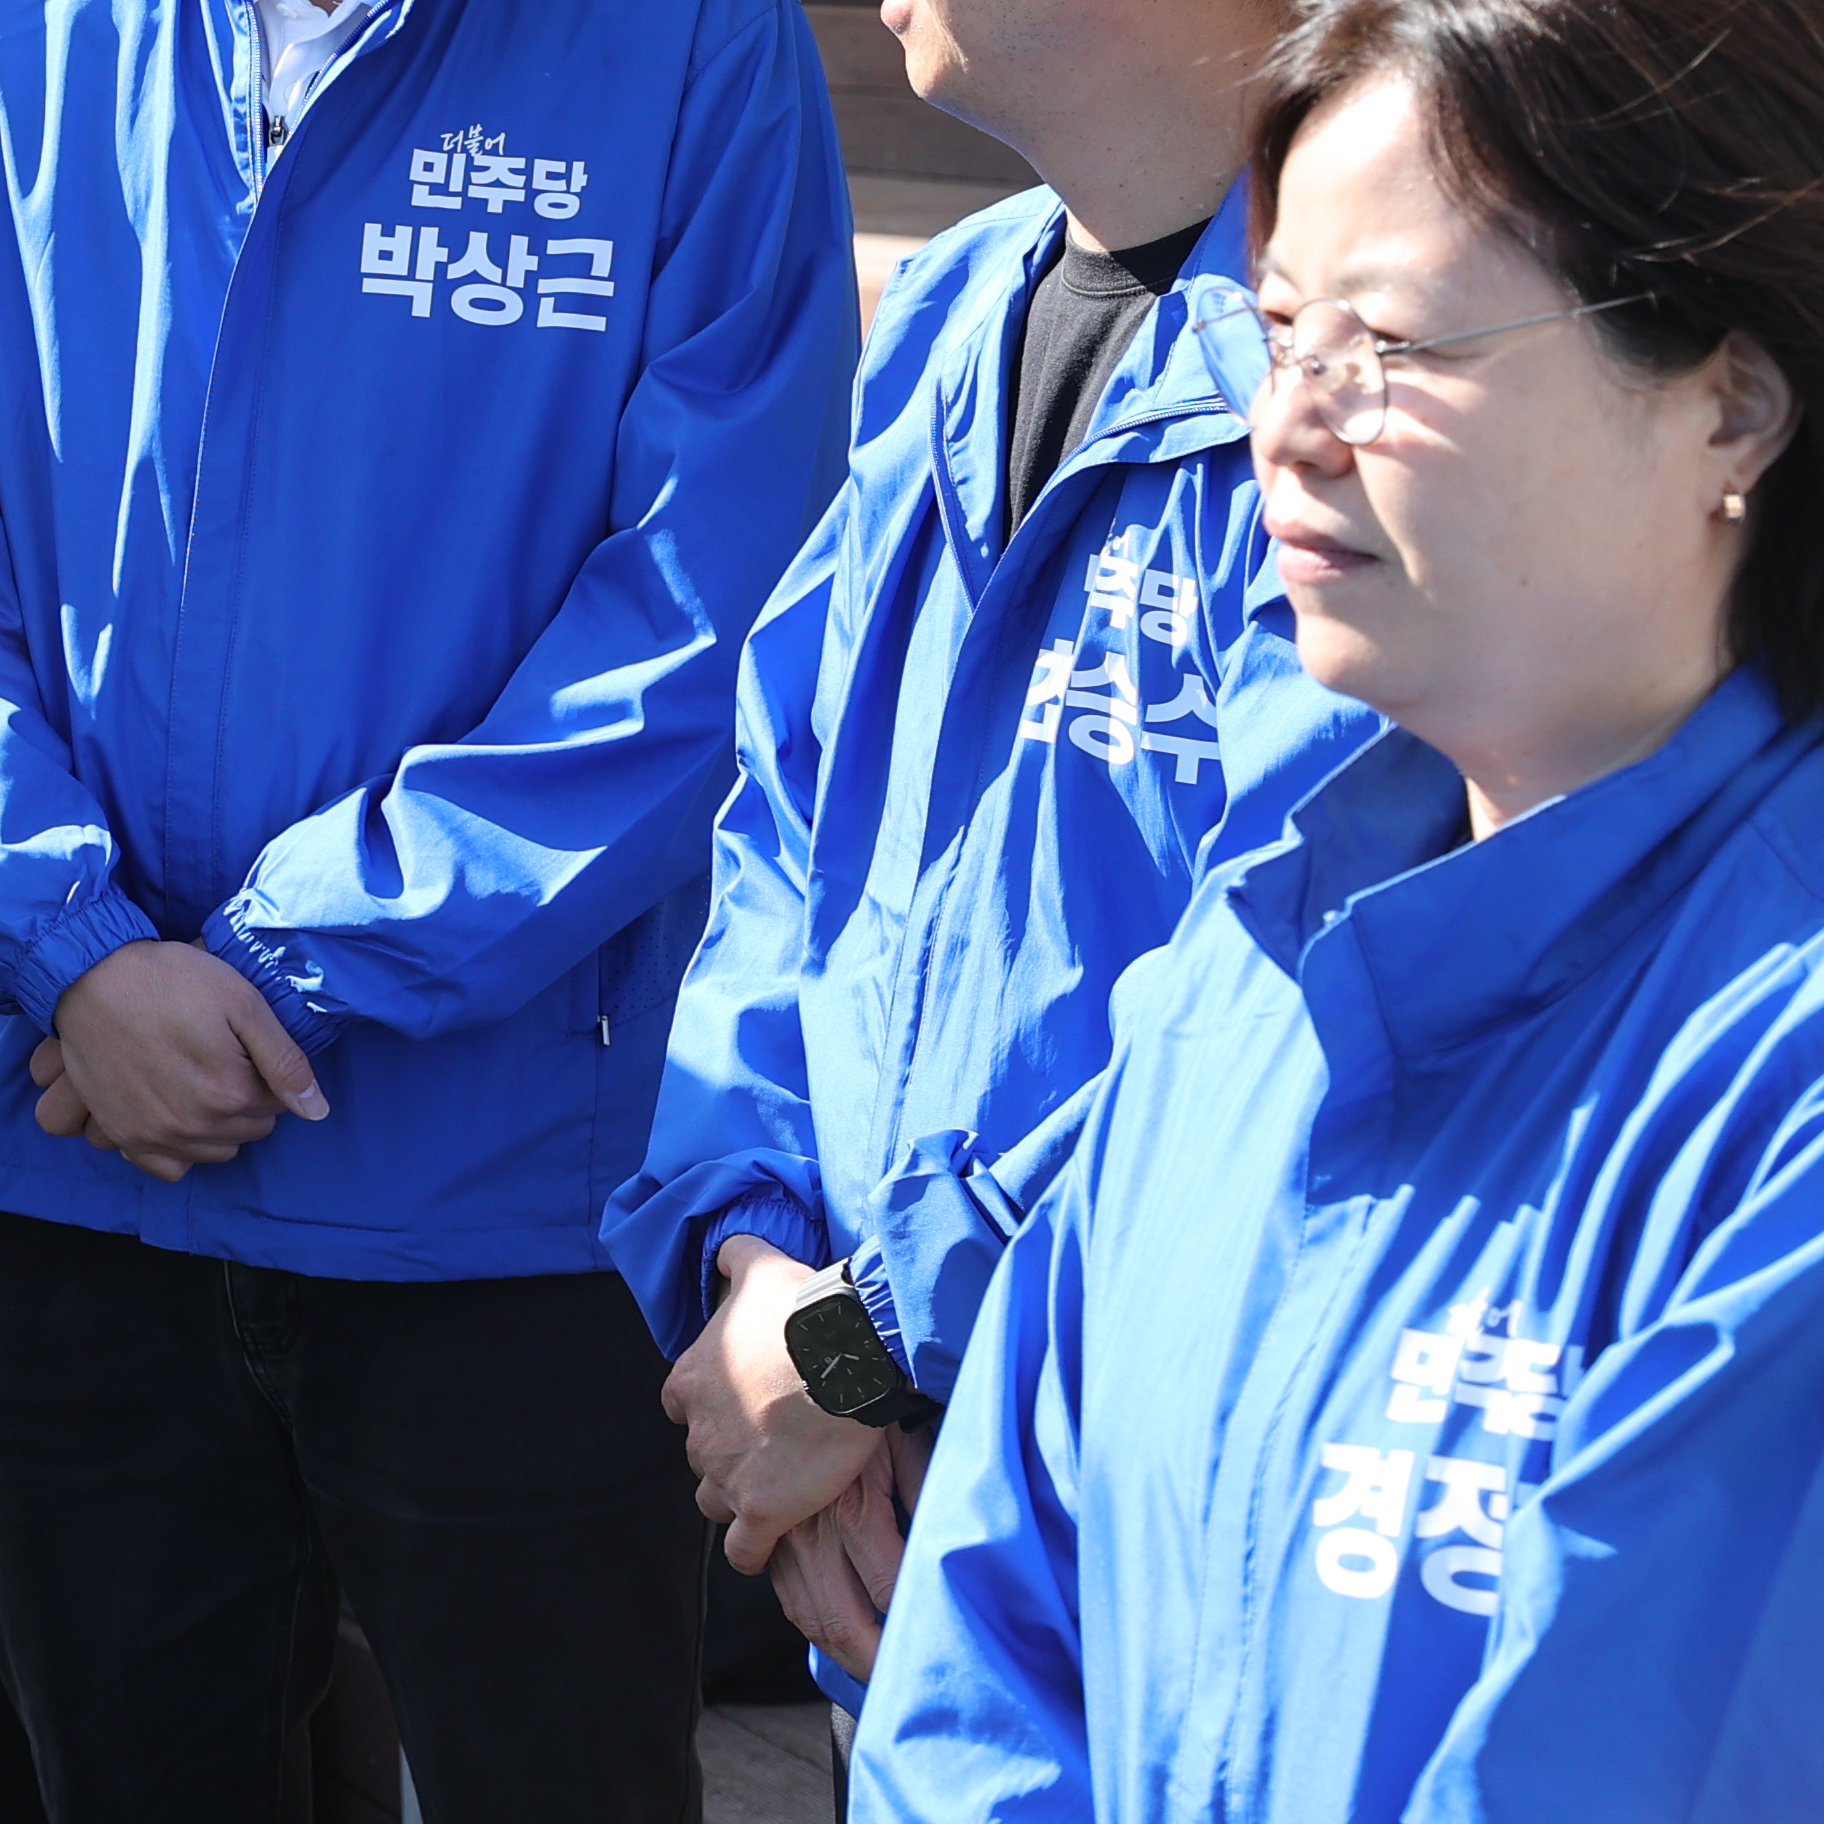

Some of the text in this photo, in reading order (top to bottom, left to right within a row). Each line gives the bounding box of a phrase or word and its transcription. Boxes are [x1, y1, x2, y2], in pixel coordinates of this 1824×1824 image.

[440, 123, 507, 157] 더불어
[409, 148, 588, 220] 민주당
[360, 222, 615, 332] 박상근
